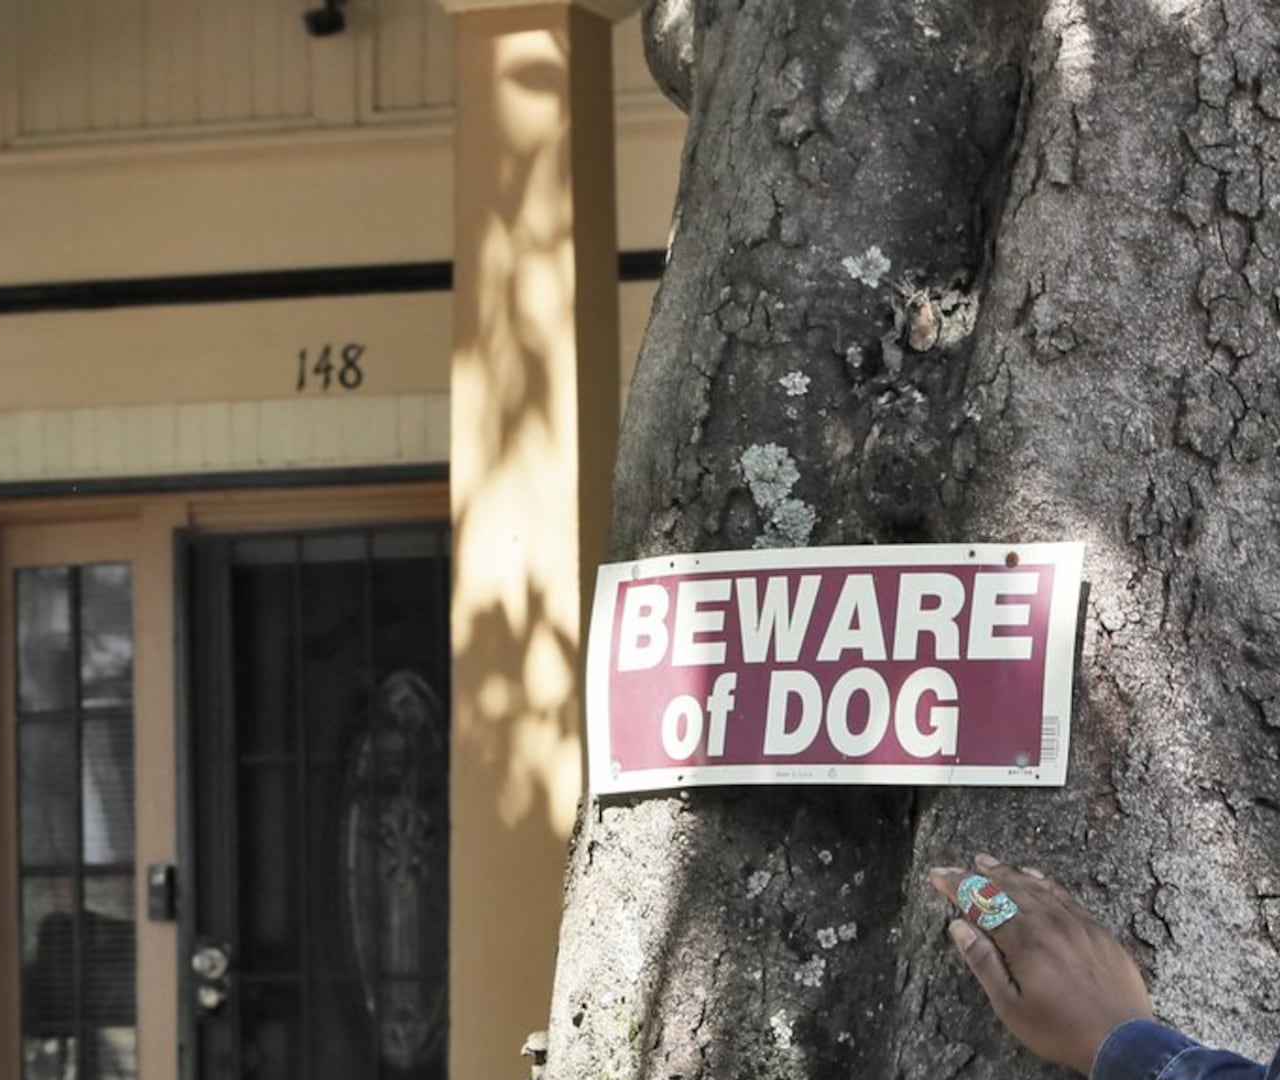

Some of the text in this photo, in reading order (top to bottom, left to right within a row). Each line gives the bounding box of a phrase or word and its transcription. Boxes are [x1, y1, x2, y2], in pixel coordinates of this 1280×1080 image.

[296, 343, 366, 392] 148
[617, 572, 1040, 672] BEWARE
[661, 667, 960, 761] of DOG
